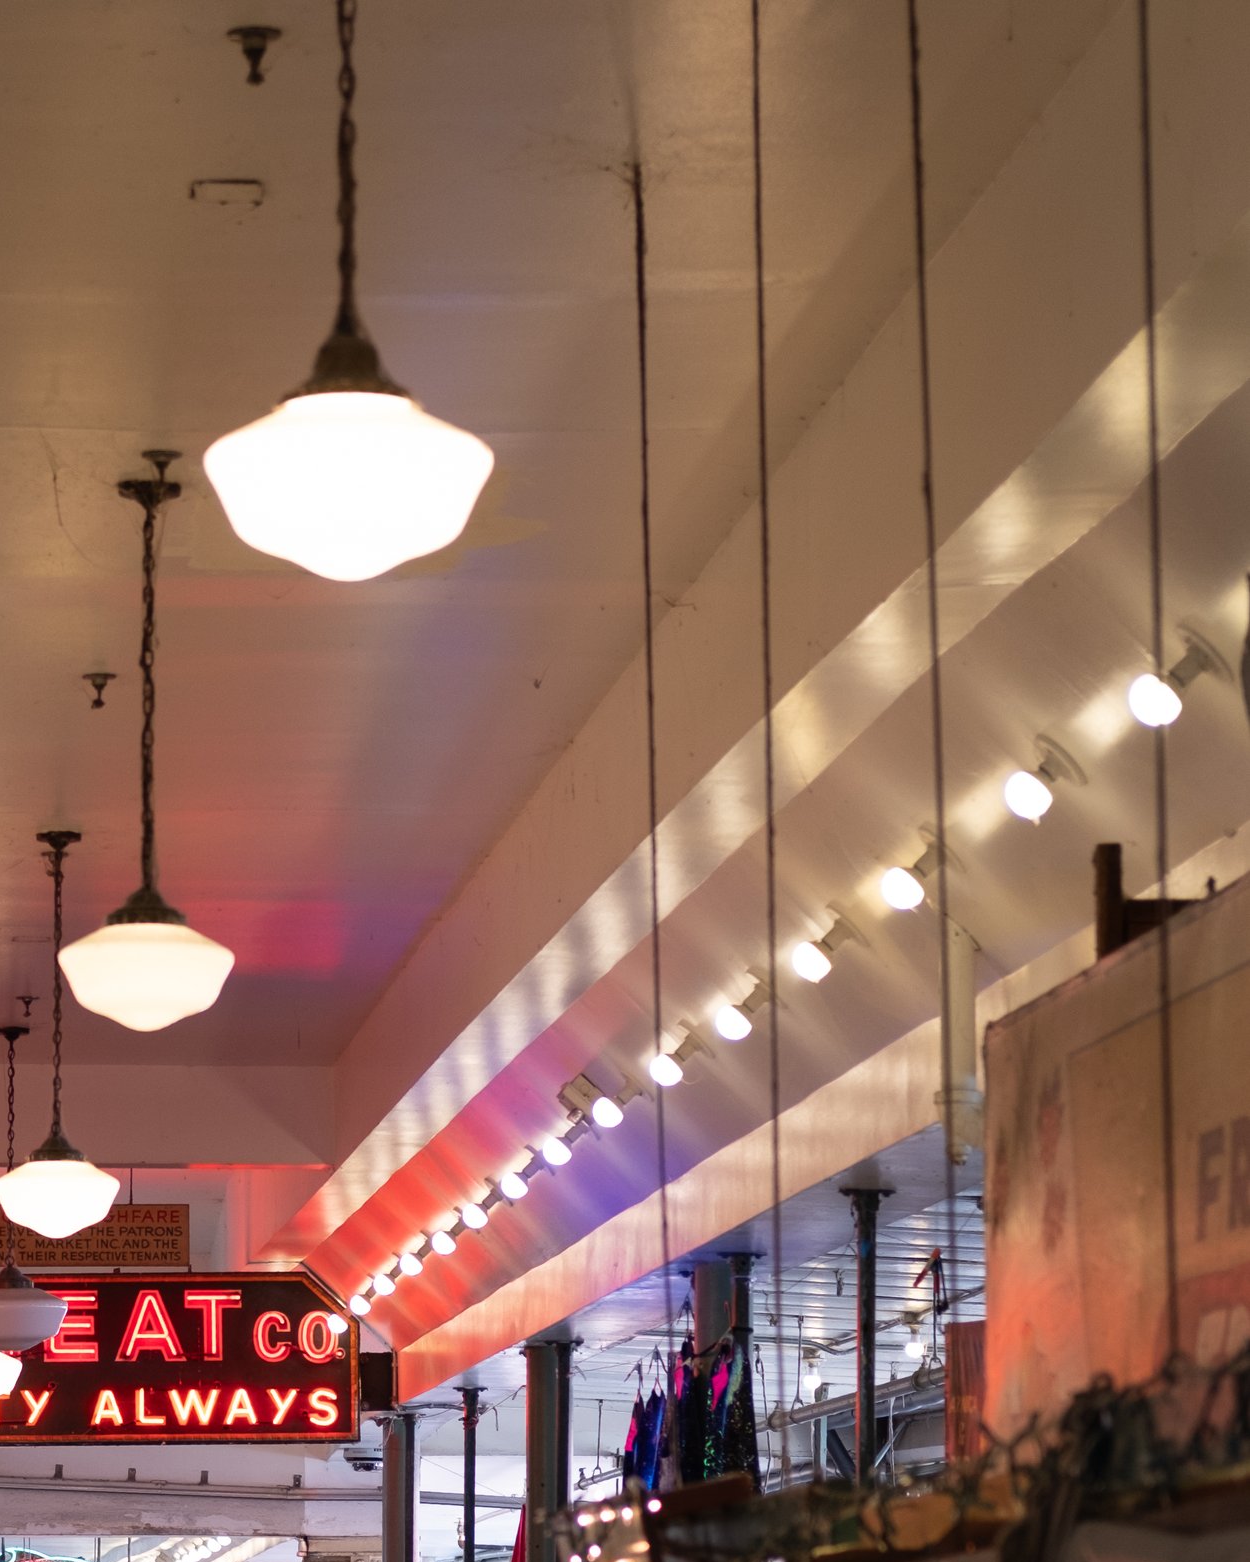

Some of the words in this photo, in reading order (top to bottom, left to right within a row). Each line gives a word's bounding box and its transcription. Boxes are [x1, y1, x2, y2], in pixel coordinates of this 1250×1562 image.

[89, 1226, 114, 1237] THE
[119, 1226, 183, 1237] PATRONS
[35, 1238, 92, 1249] MARKET
[122, 1238, 149, 1249] AND
[153, 1238, 178, 1249] THE
[19, 1251, 57, 1262] THEIR
[61, 1251, 128, 1262] RESPECTIVE
[130, 1251, 181, 1262] TENANTS
[91, 1388, 340, 1427] ALWAYS
